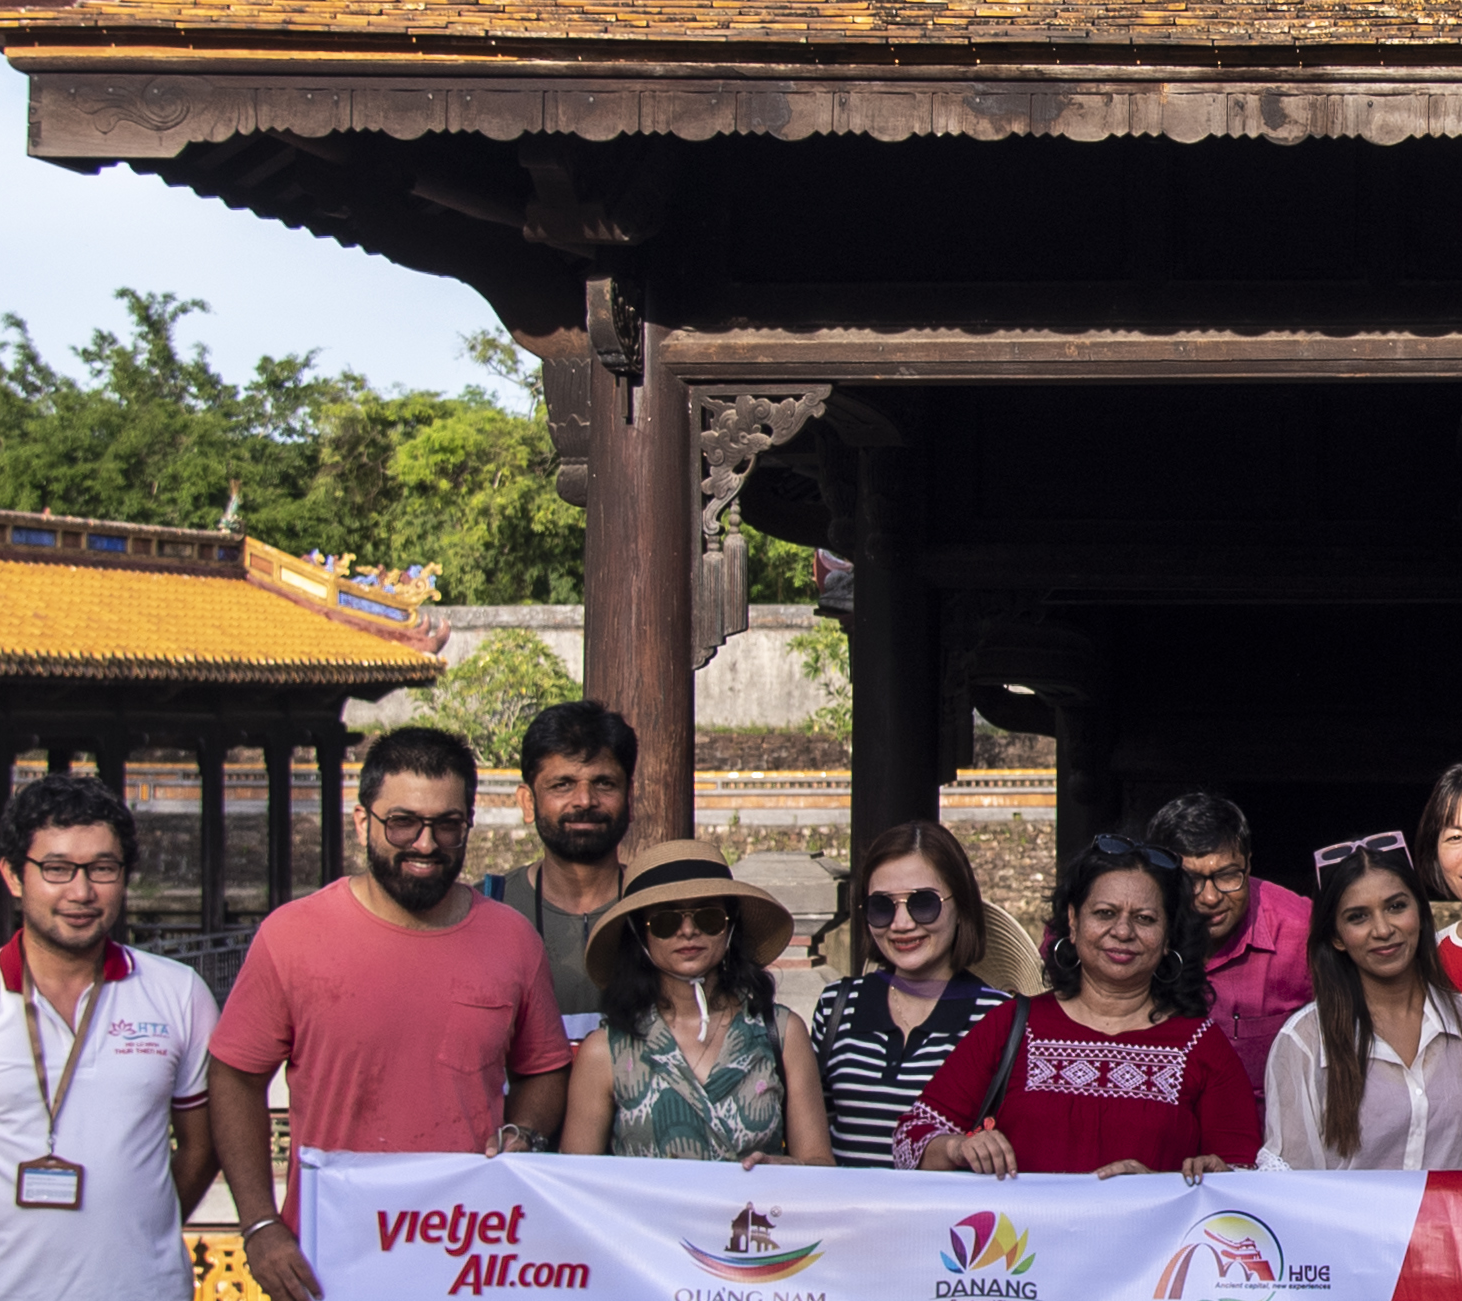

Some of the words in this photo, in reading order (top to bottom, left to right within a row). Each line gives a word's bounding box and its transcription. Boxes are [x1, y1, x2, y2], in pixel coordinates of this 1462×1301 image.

[138, 1022, 170, 1034] HTA
[935, 1278, 1038, 1300] DANANG
[1215, 1282, 1244, 1290] Ancient
